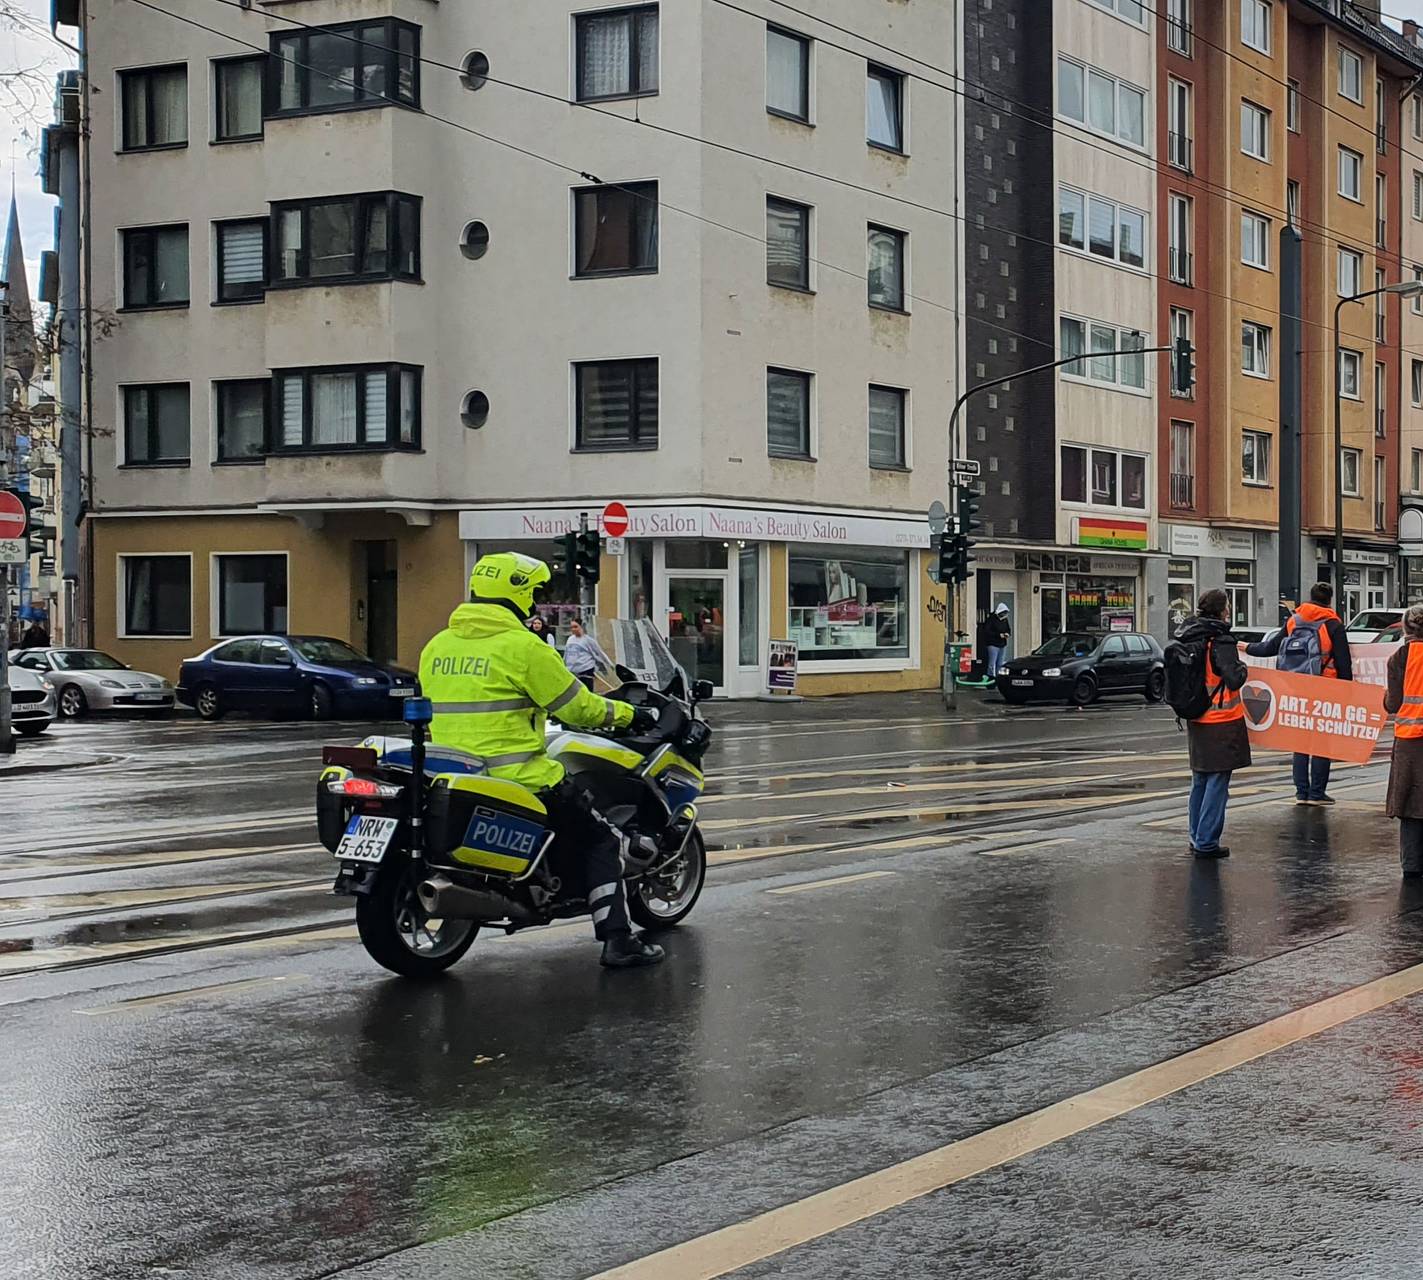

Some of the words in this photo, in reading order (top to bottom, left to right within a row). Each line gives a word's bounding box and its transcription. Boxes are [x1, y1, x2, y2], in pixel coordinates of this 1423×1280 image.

[522, 515, 581, 534] Naana'
[597, 514, 647, 535] Buty
[651, 513, 697, 533] Salon
[709, 511, 763, 535] Naana's
[767, 516, 810, 539] Beauty
[812, 519, 847, 540] Salon
[431, 656, 490, 677] POLIZEI
[1279, 694, 1309, 715] ART.
[1312, 700, 1342, 719] 20A
[1345, 705, 1367, 723] GG
[1278, 712, 1314, 731] LEBEN
[1316, 718, 1380, 741] SCHÜTZEN
[356, 818, 386, 838] NRW
[473, 821, 536, 854] POLIZEI
[338, 837, 385, 858] 5-653
